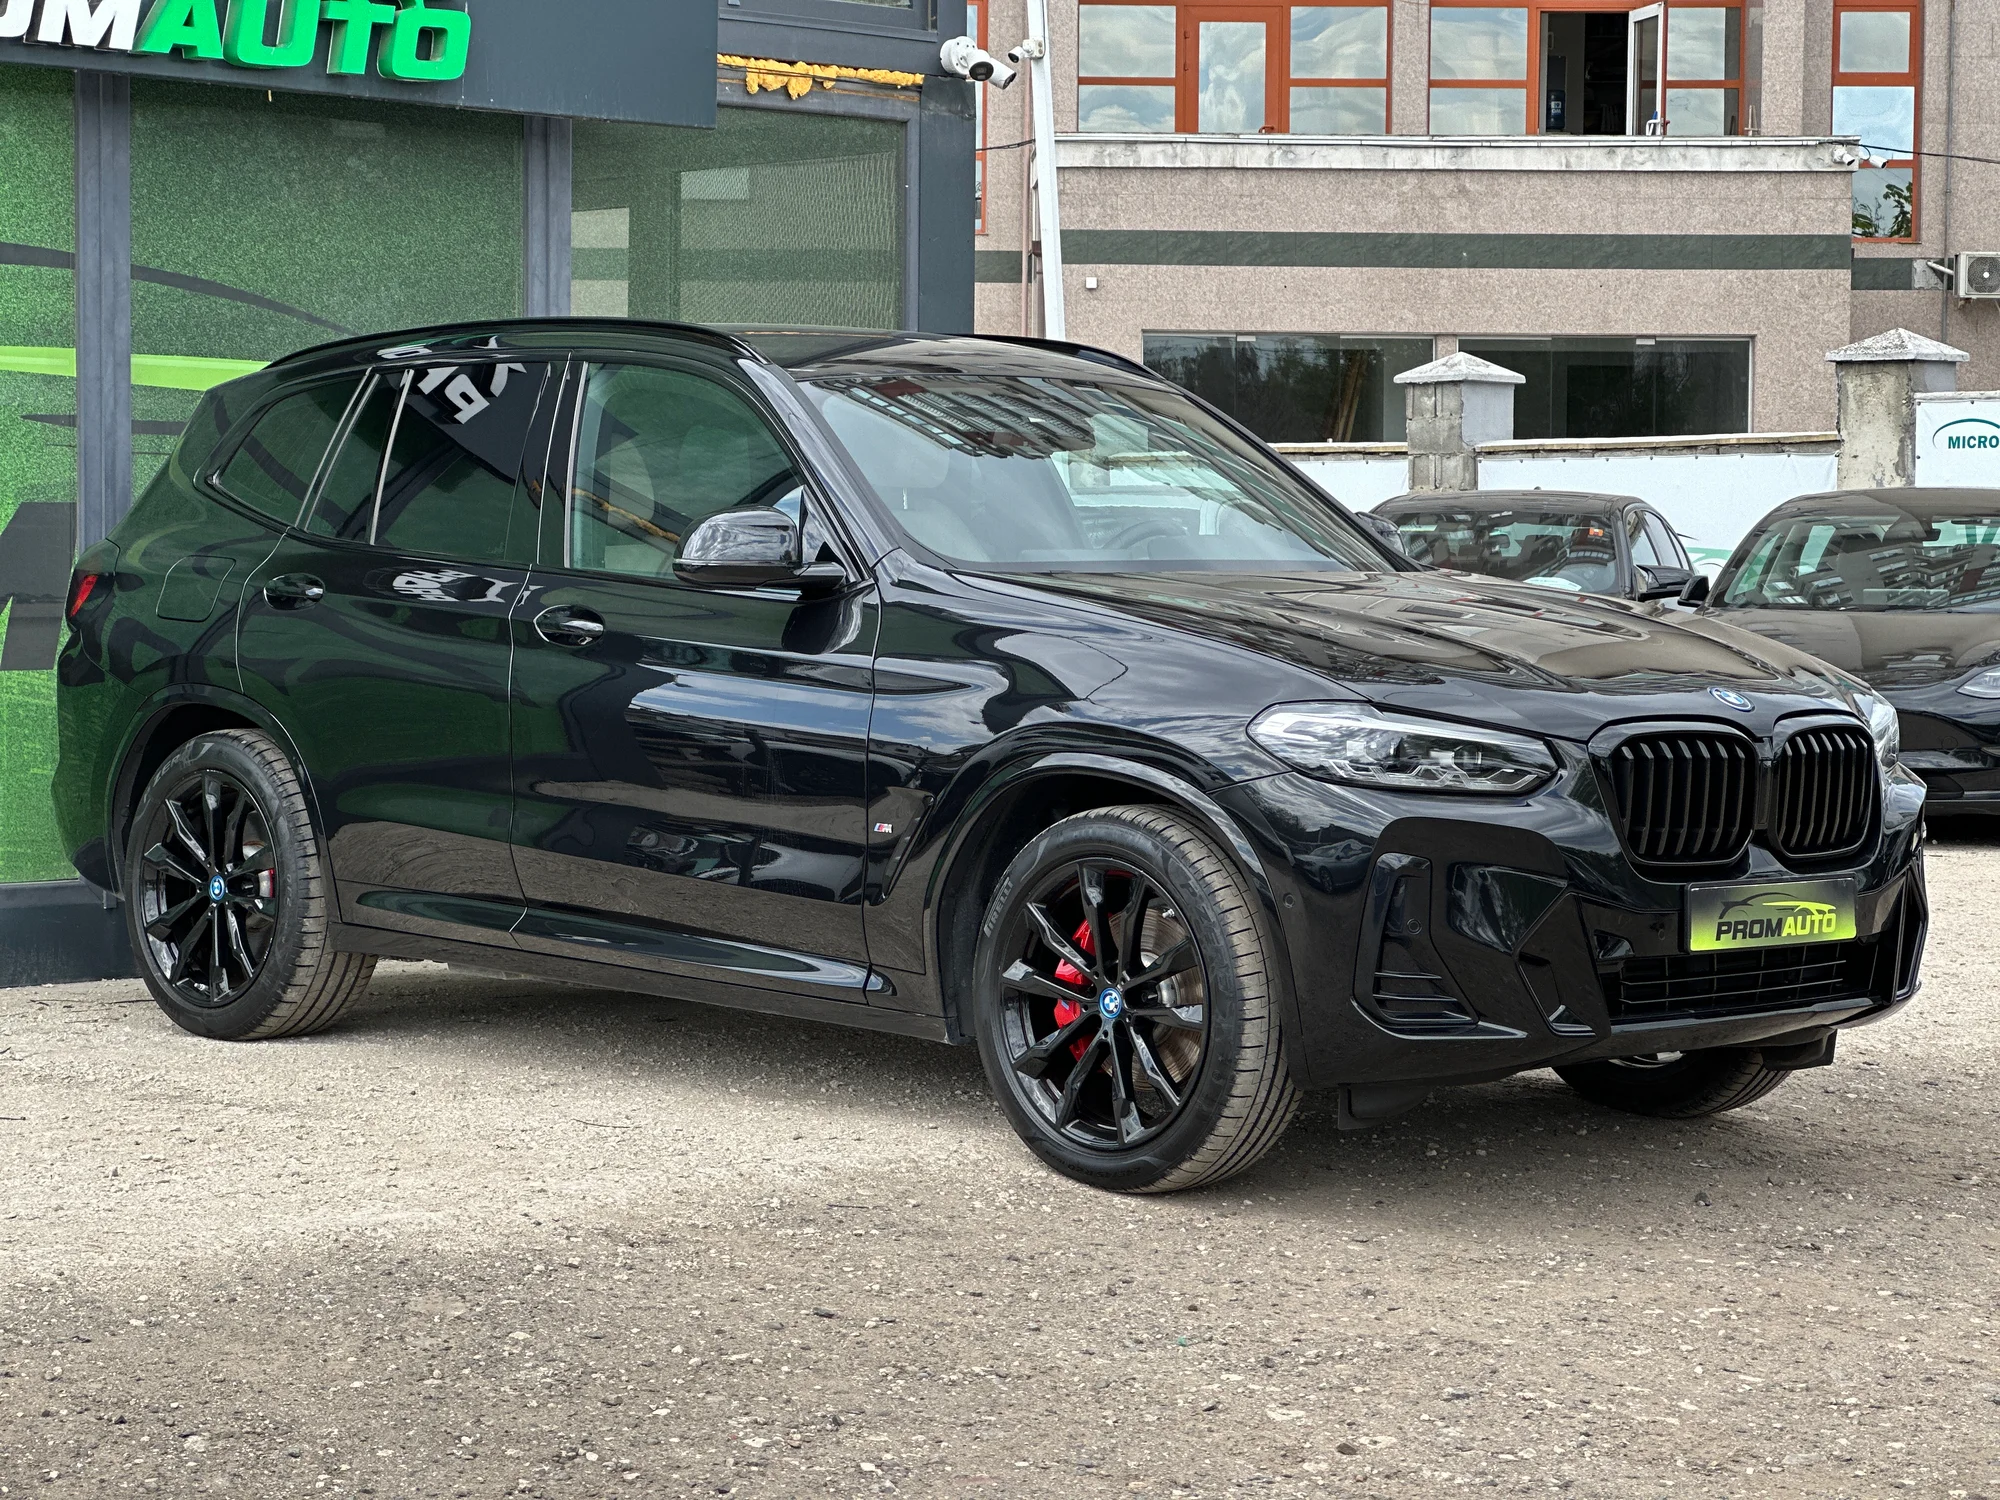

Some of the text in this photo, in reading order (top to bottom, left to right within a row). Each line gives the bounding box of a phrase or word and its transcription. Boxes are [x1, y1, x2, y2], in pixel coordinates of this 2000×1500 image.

[0, 0, 471, 81] MAUTO
[1947, 435, 2000, 449] MICRO
[983, 876, 1014, 938] PIRELLI
[1715, 912, 1837, 942] PROMAUTO
